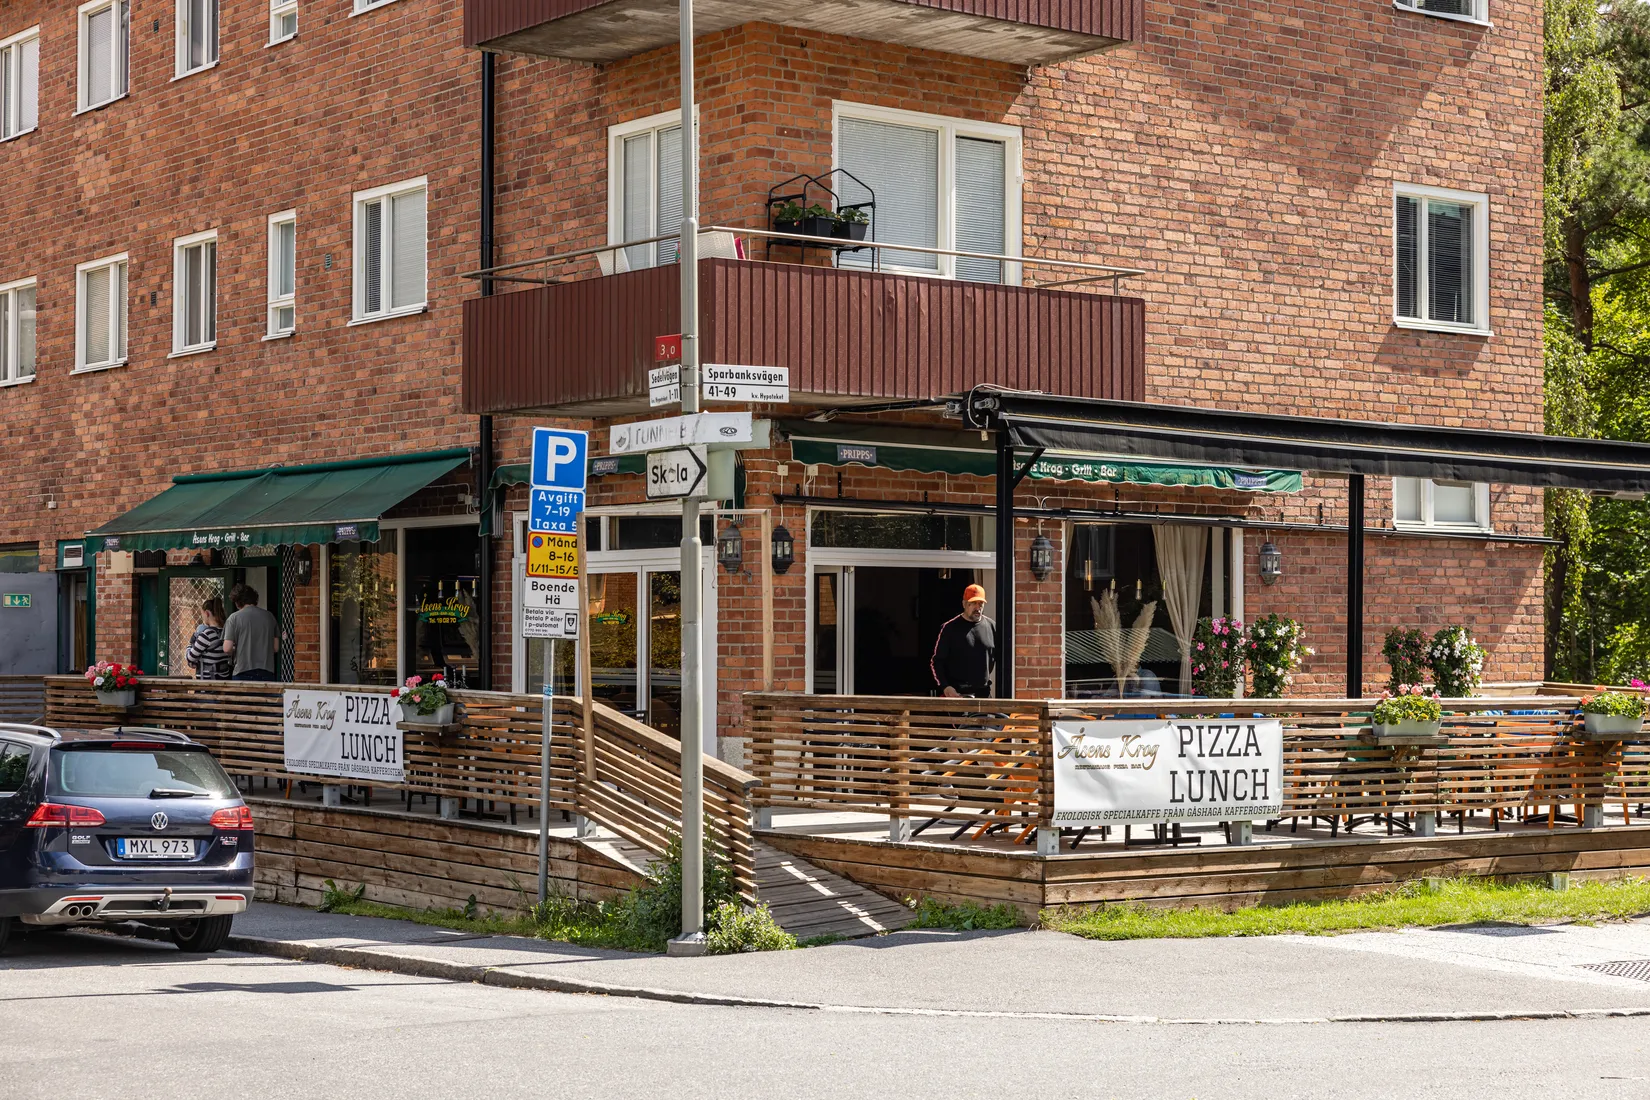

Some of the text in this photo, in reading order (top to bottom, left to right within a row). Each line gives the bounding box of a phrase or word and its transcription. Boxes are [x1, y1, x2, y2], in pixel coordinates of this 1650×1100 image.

[660, 344, 676, 359] 3,0
[708, 368, 783, 383] Sparbanksvägen
[669, 388, 679, 400] 1-11
[708, 386, 737, 398] 41-49
[546, 435, 577, 482] P
[843, 449, 871, 460] PRIPPS
[1040, 461, 1063, 476] Krog
[1072, 463, 1092, 475] Grill
[1100, 465, 1117, 477] Bar
[538, 491, 578, 504] Avgift
[544, 505, 570, 517] 7-19
[535, 518, 577, 531] Taxa 5
[193, 531, 207, 544] Åsens
[208, 533, 220, 545] Krog
[240, 532, 250, 541] Bar
[547, 537, 578, 548] Månd
[549, 551, 575, 562] 8-16
[530, 563, 578, 575] 1/11-15/5
[531, 581, 575, 593] Boende
[545, 594, 560, 605] Hä
[445, 597, 470, 618] Krog
[286, 694, 336, 731] Åsens Krog
[345, 695, 391, 725] PIZZA
[341, 732, 396, 763] LUNCH
[1177, 724, 1262, 758] PIZZA
[1057, 727, 1160, 771] Åsens Krog
[1169, 768, 1270, 803] LUNCH
[1056, 805, 1280, 821] EKOLOGISK SPECIALKAFFE FRÅN GÅSHAGA KAFFEROSTERI
[130, 840, 189, 853] MXL 973
